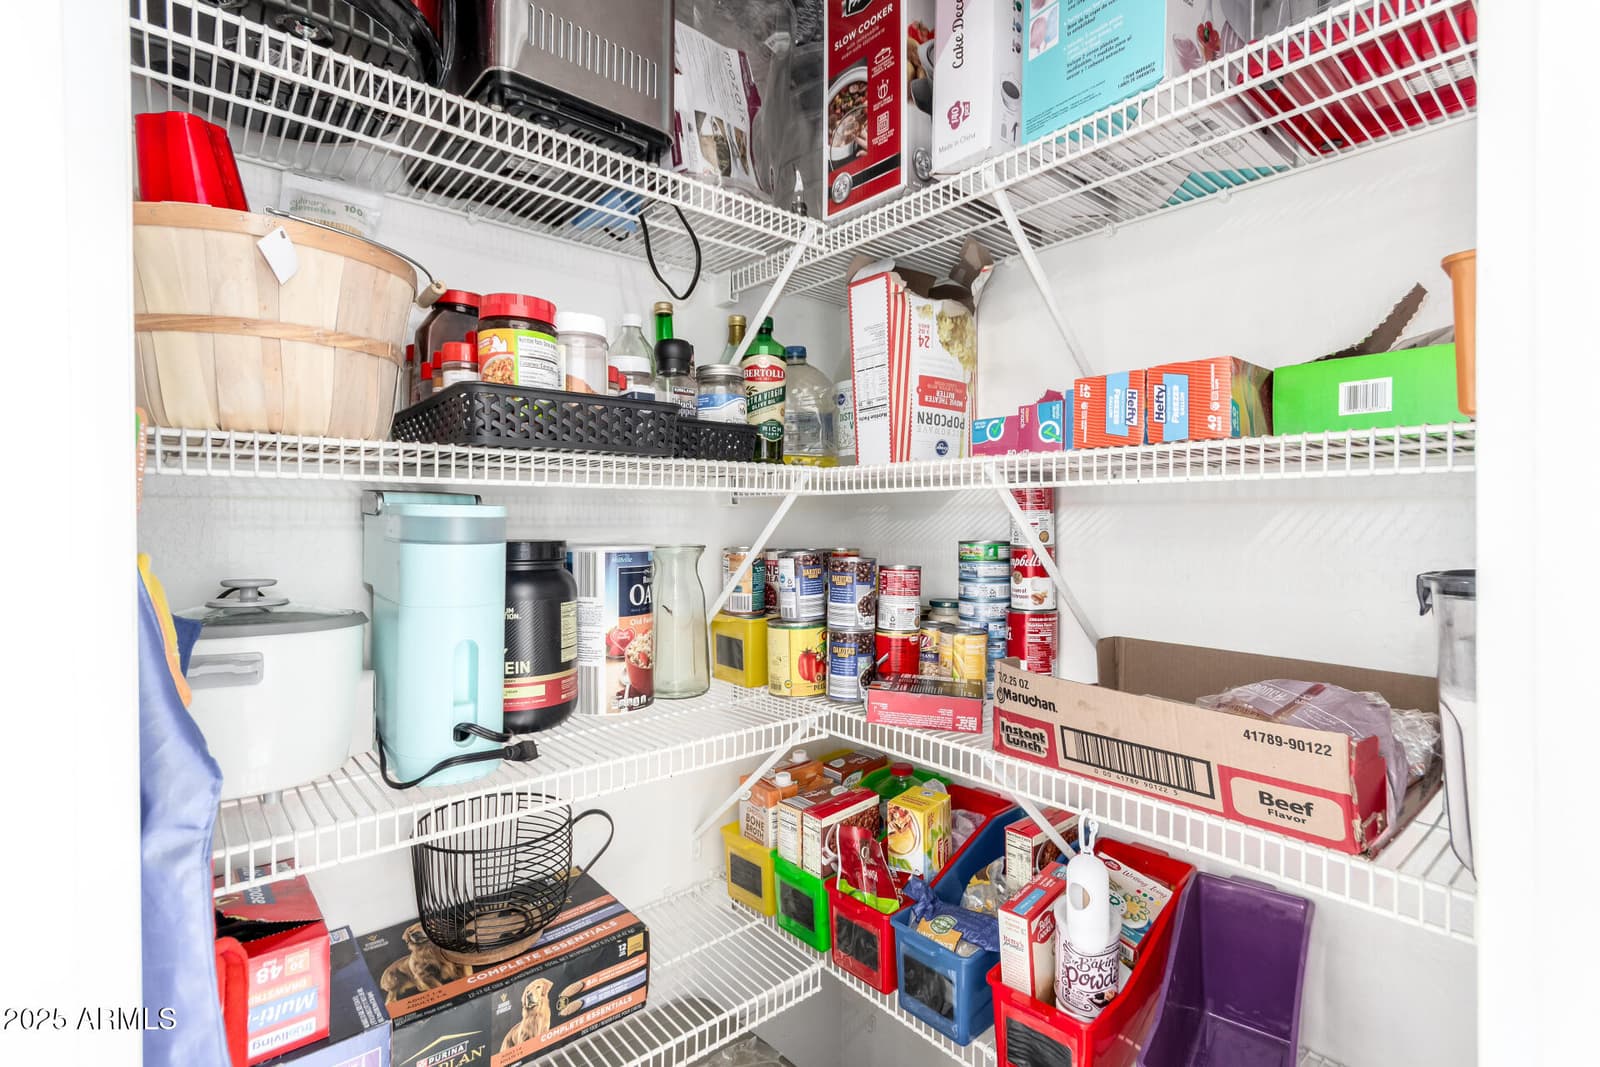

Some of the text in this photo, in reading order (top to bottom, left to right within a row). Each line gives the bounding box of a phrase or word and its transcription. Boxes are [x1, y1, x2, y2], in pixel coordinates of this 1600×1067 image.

[834, 3, 893, 51] SLOW COOKER
[952, 34, 964, 69] Cake
[344, 204, 363, 217] 100
[918, 335, 930, 348] 24
[743, 368, 784, 379] BERTOLLI
[1125, 390, 1137, 425] Hefty
[1155, 386, 1167, 421] Hefty
[762, 425, 782, 433] RICH
[917, 411, 965, 430] POPCORN
[1207, 414, 1217, 431] 40
[629, 584, 652, 606] OA
[504, 661, 531, 675] EIN
[1018, 678, 1030, 690] OZ
[1001, 720, 1045, 744] Instant
[1243, 729, 1333, 757] 41789-90122
[1143, 781, 1168, 793] 90122
[1258, 790, 1314, 817] Beef
[745, 813, 765, 832] BONE
[1267, 808, 1308, 825] Flavor
[745, 823, 764, 841] BROTH
[466, 951, 542, 985] COMPLETE
[543, 920, 619, 955] ESSENTIALS
[256, 964, 283, 985] 48
[1077, 956, 1115, 973] Bakin
[252, 990, 316, 1027] Multi-
[541, 995, 633, 1043] COMPLETE ESSENTIALS
[428, 1044, 466, 1065] PURINA
